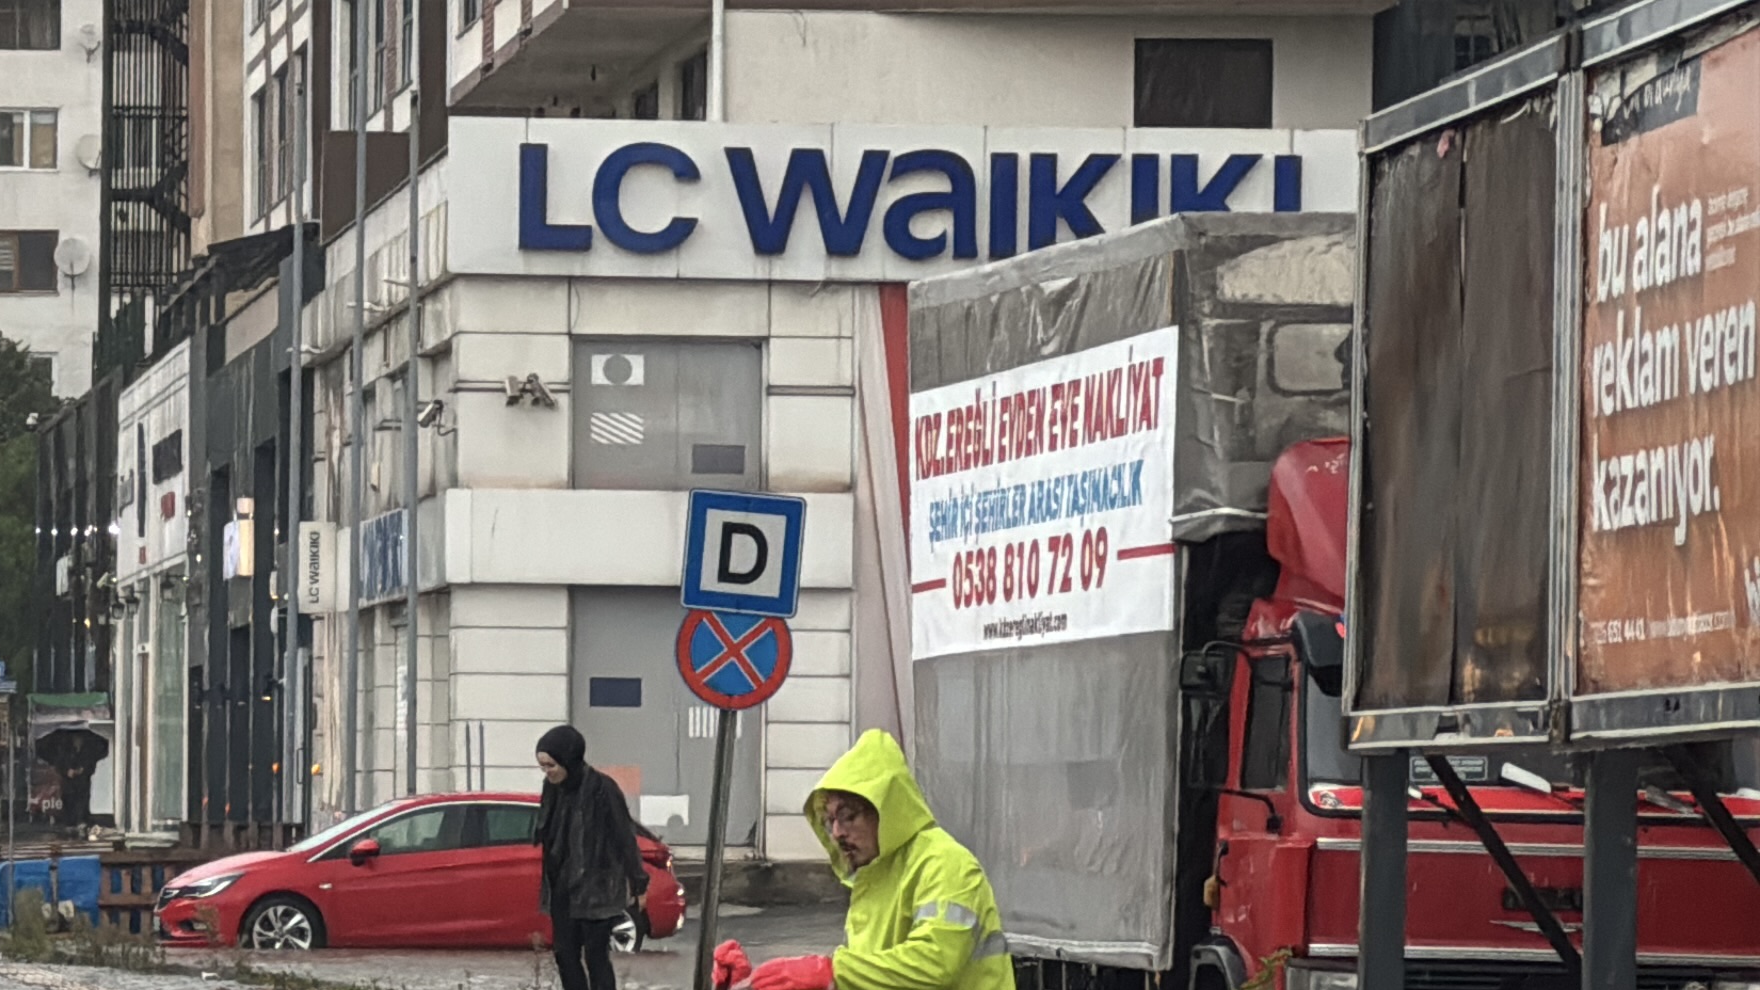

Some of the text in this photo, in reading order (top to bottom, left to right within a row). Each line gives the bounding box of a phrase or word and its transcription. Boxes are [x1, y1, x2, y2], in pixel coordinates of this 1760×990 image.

[518, 142, 701, 254] LC
[1597, 183, 1702, 302] bu alana
[998, 387, 1047, 463] EVDEN
[1049, 378, 1081, 452] EVE
[1082, 344, 1165, 446] NAKLİYAT
[1593, 299, 1756, 419] reklam veren
[929, 487, 958, 554] ŞEHİR
[975, 477, 1026, 546] ŞEHİRLER
[1026, 474, 1065, 525] ARASI
[1066, 459, 1145, 528] TAŞIMACILIK
[1591, 433, 1721, 546] kazanıyor.
[308, 587, 320, 604] LC
[717, 521, 768, 585] D
[952, 526, 1108, 610] 0538 810 72 09
